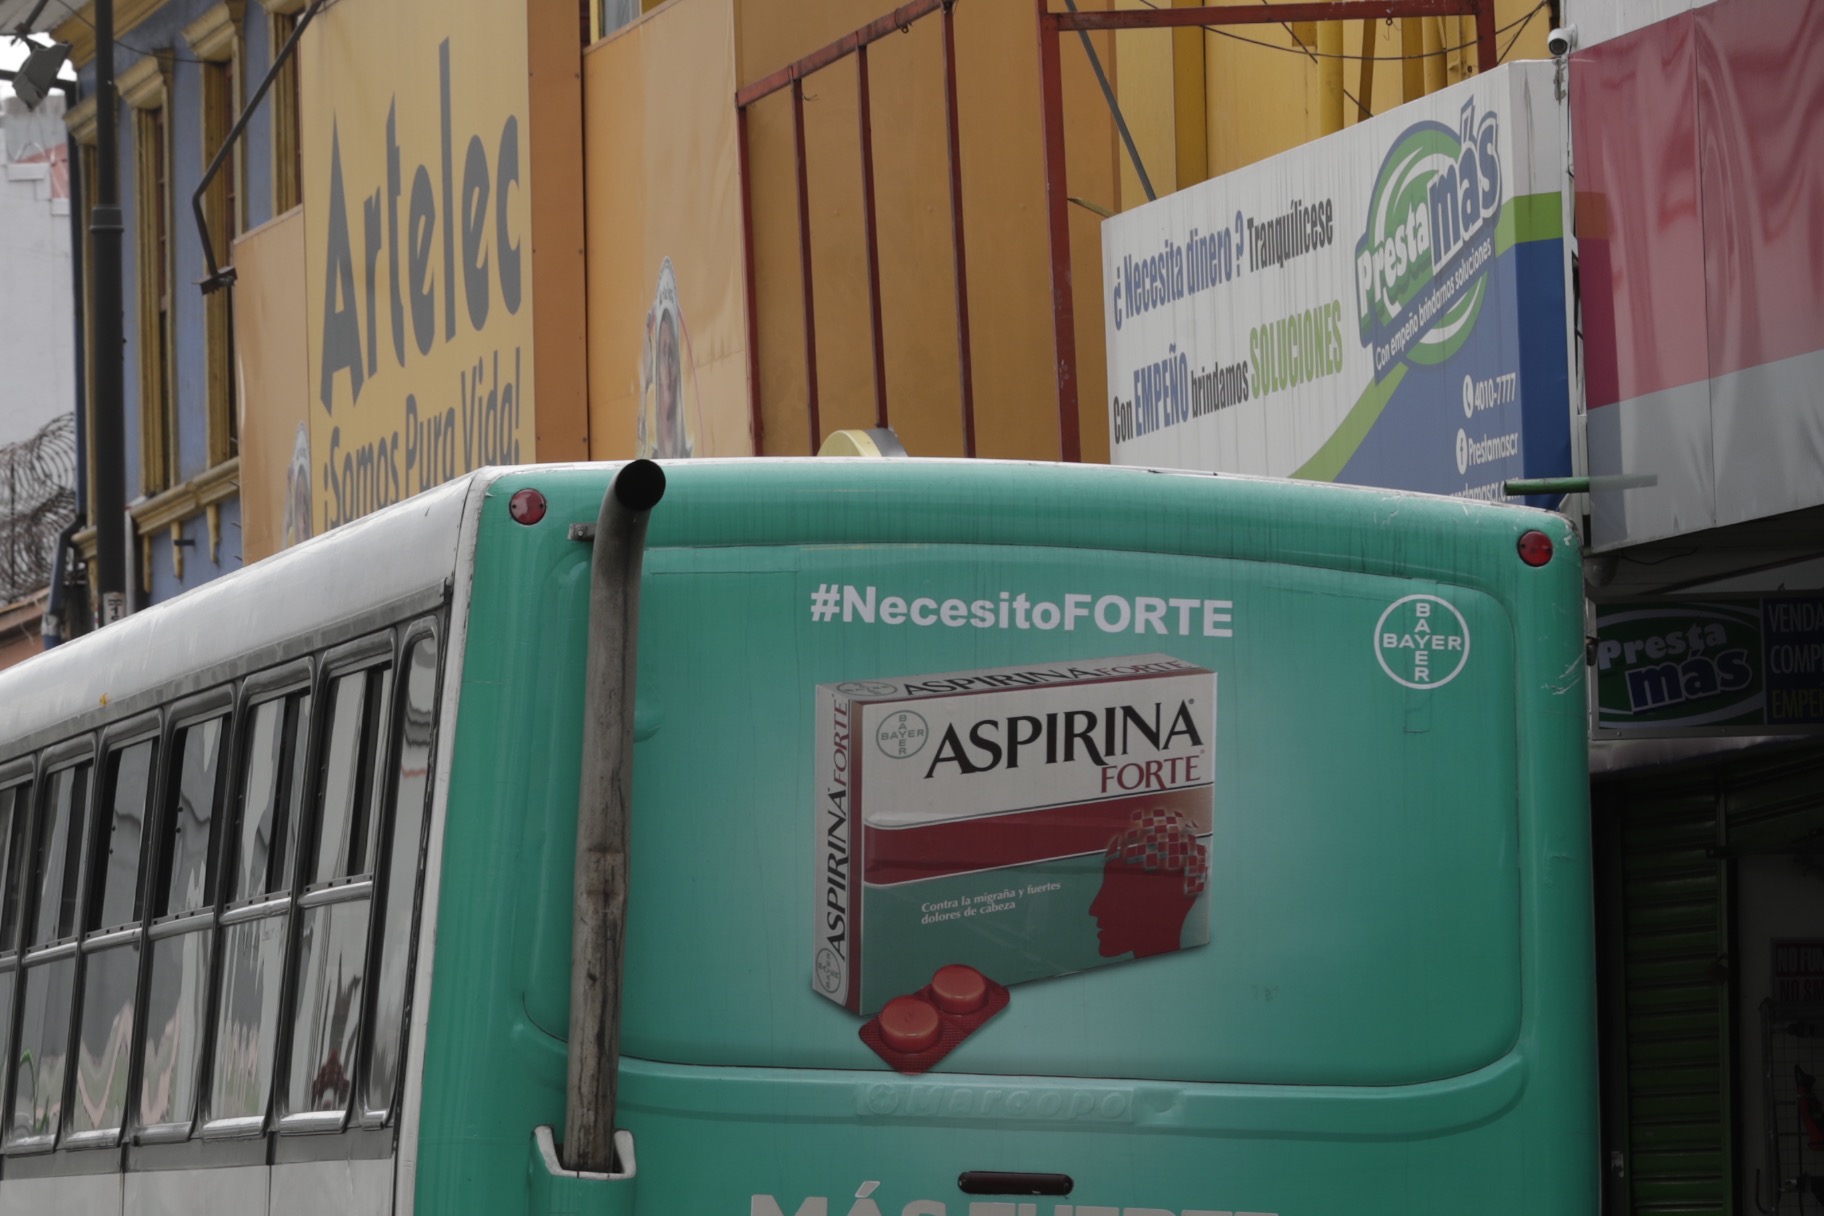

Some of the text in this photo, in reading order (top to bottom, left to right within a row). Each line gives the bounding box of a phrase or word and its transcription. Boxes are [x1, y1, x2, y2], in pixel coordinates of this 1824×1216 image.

[320, 36, 522, 418] Artelec
[1124, 239, 1184, 319] Necesita
[1186, 228, 1233, 296] dinero
[1247, 198, 1334, 272] Tranquílicese
[1376, 237, 1492, 371] Con empeño brindamos soluciones
[1113, 299, 1344, 445] Con EMPEÑO brindamos SOLUCIONES
[1475, 372, 1516, 411] 4010-7777
[405, 393, 456, 500] Pura
[460, 346, 521, 476] Vida!
[1468, 432, 1518, 466] Prestamascr
[810, 583, 1234, 637] #NecesitoFORTE
[1382, 632, 1463, 651] BAYER
[1414, 602, 1432, 682] BAYER
[1597, 621, 1728, 670] Presta
[1770, 644, 1824, 674] COMP
[904, 667, 1100, 697] ASPIRINA
[1096, 660, 1193, 677] FORTE
[1626, 647, 1753, 713] más
[1772, 682, 1824, 719] EMPE
[833, 699, 848, 786] FORTE
[880, 728, 925, 741] BAYER
[924, 699, 1204, 780] ASPIRINA
[1100, 755, 1201, 793] FORTE
[827, 788, 849, 961] ASPIRINA
[921, 882, 1062, 913] Contra la migraña y fuertes
[921, 901, 1016, 925] dolores de cabeza
